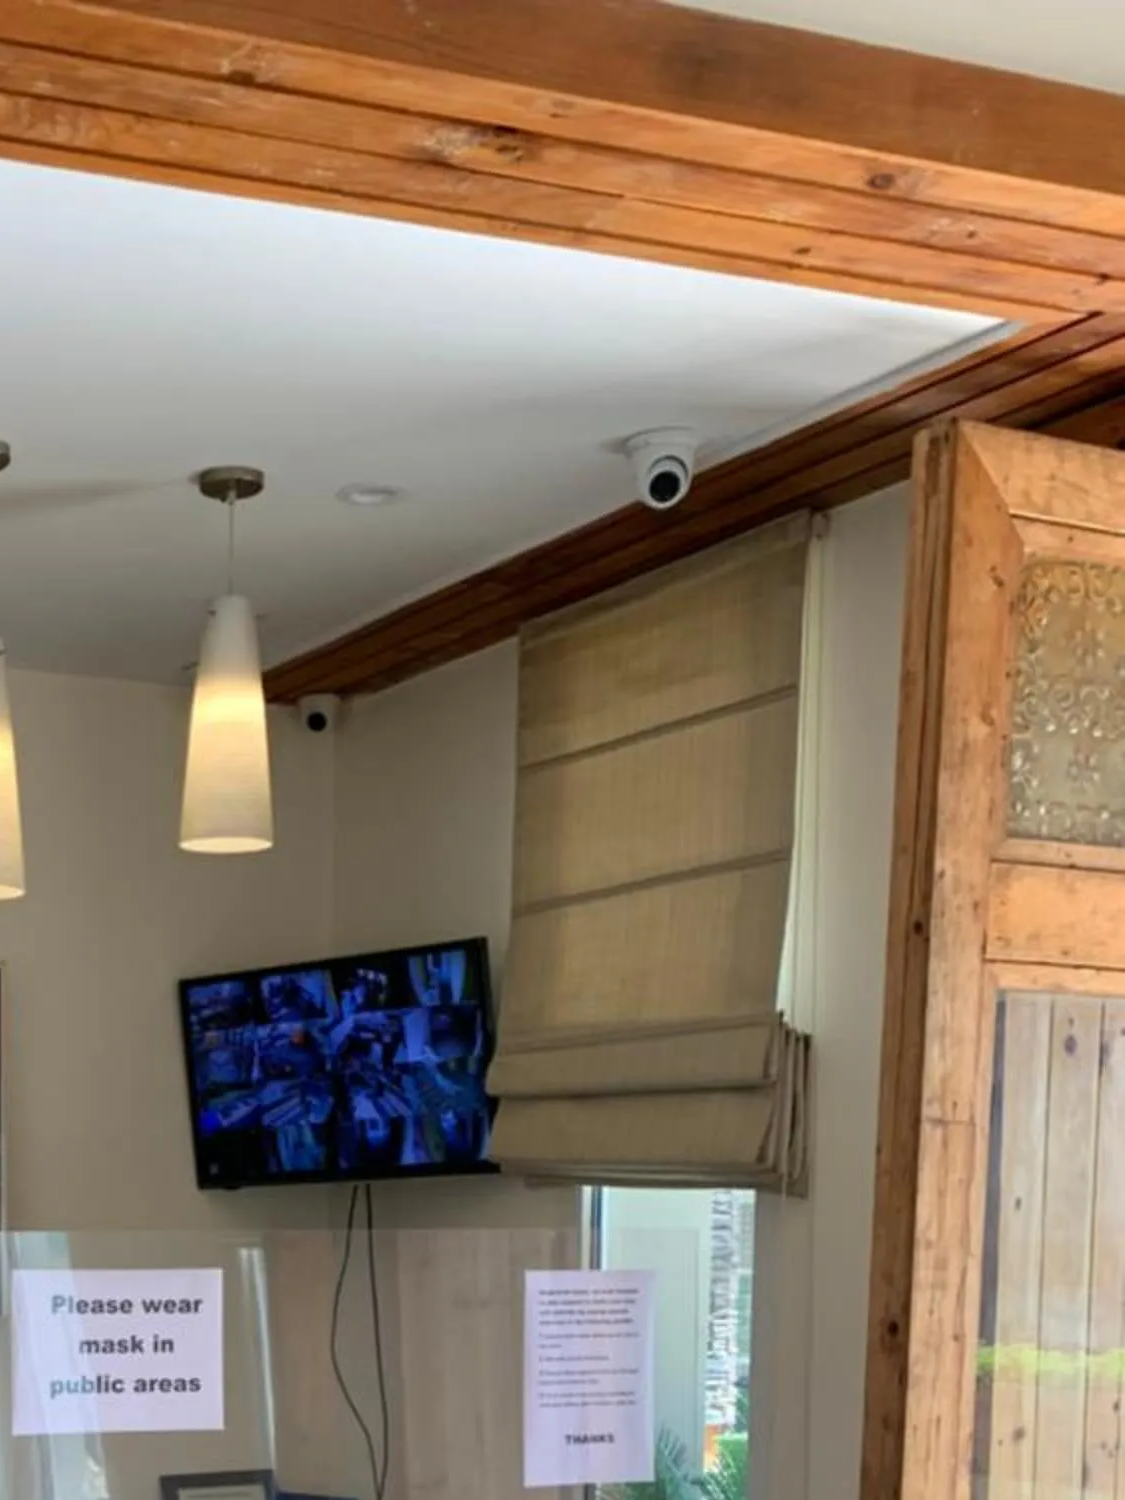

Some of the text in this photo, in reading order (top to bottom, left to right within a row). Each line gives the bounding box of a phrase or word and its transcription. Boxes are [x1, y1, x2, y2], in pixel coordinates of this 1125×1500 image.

[50, 1295, 204, 1316] Please wear
[78, 1333, 176, 1355] mask in
[49, 1373, 202, 1400] public areas
